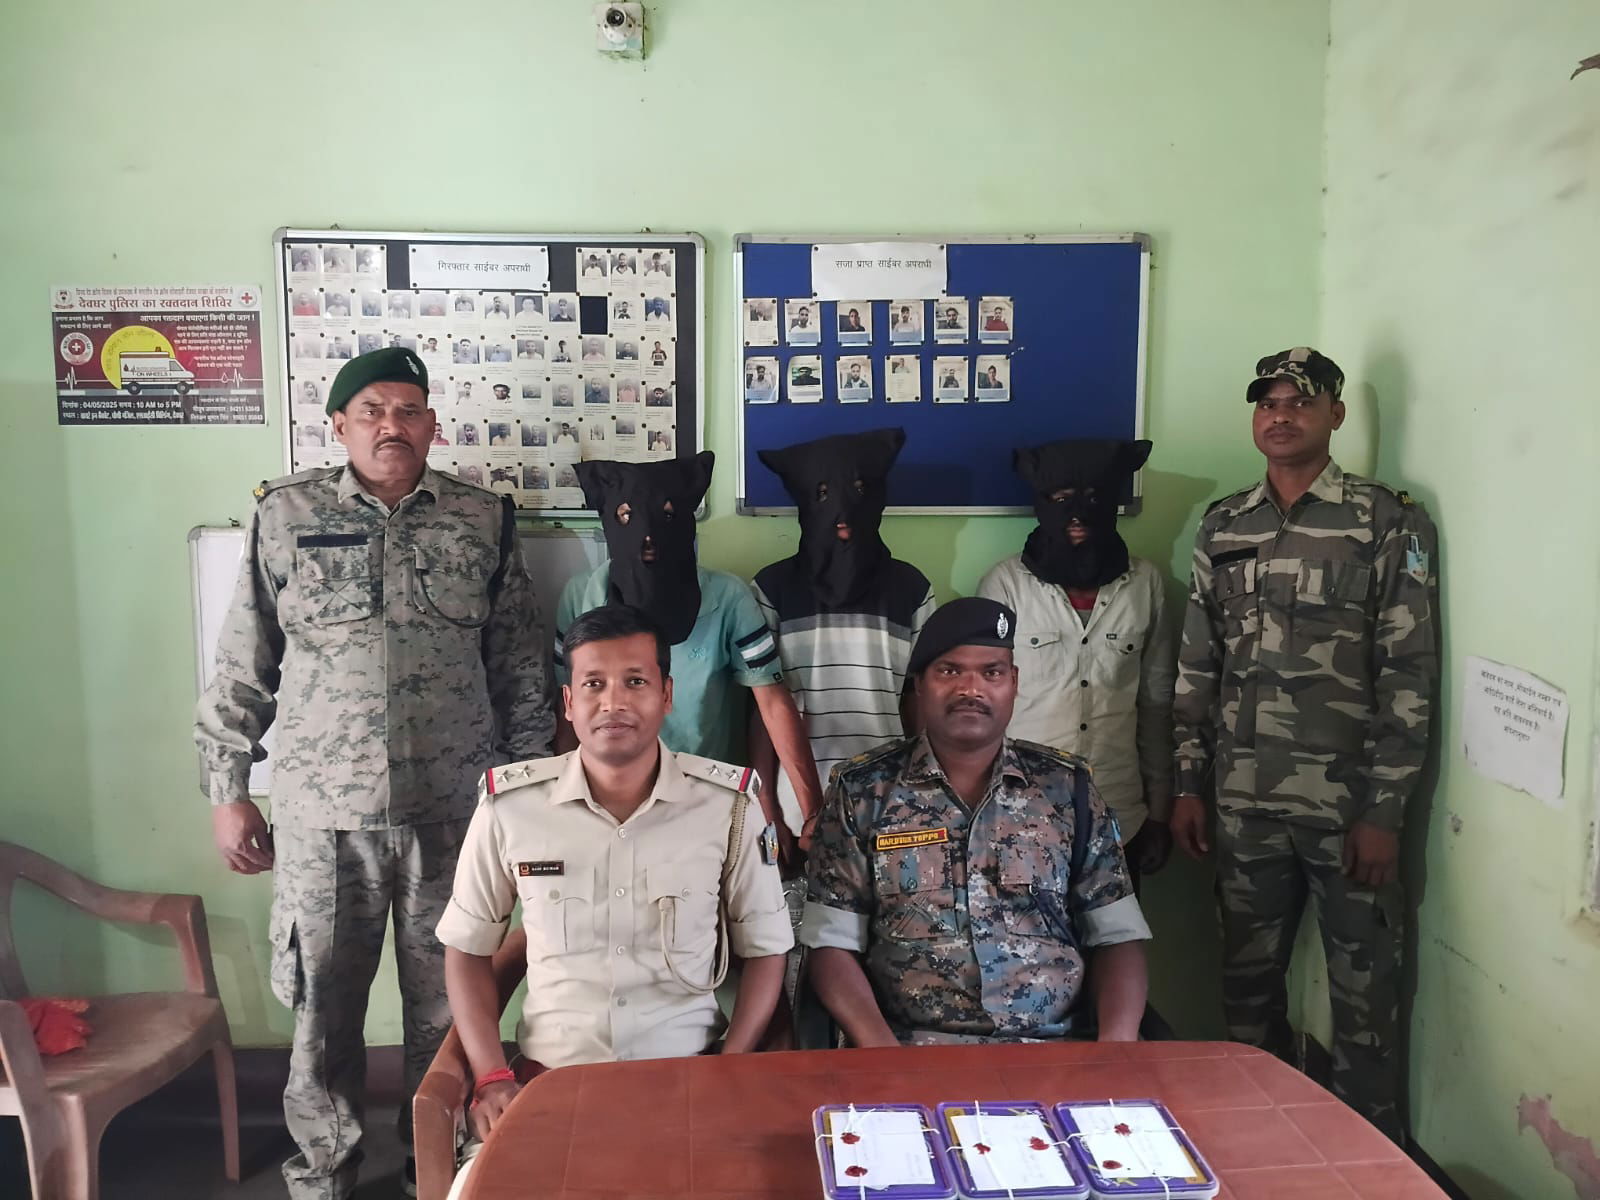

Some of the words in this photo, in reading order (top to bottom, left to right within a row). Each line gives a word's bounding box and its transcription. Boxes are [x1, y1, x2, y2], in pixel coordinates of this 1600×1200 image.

[503, 263, 531, 272] अपराधी
[835, 260, 853, 268] सजा
[856, 260, 873, 268] प्राप्त
[905, 259, 932, 269] अपराधी
[79, 297, 106, 308] देवघर
[109, 296, 138, 312] पुलिस
[142, 300, 156, 308] का
[160, 299, 198, 308] रक्तदान
[201, 296, 232, 308] शिविर
